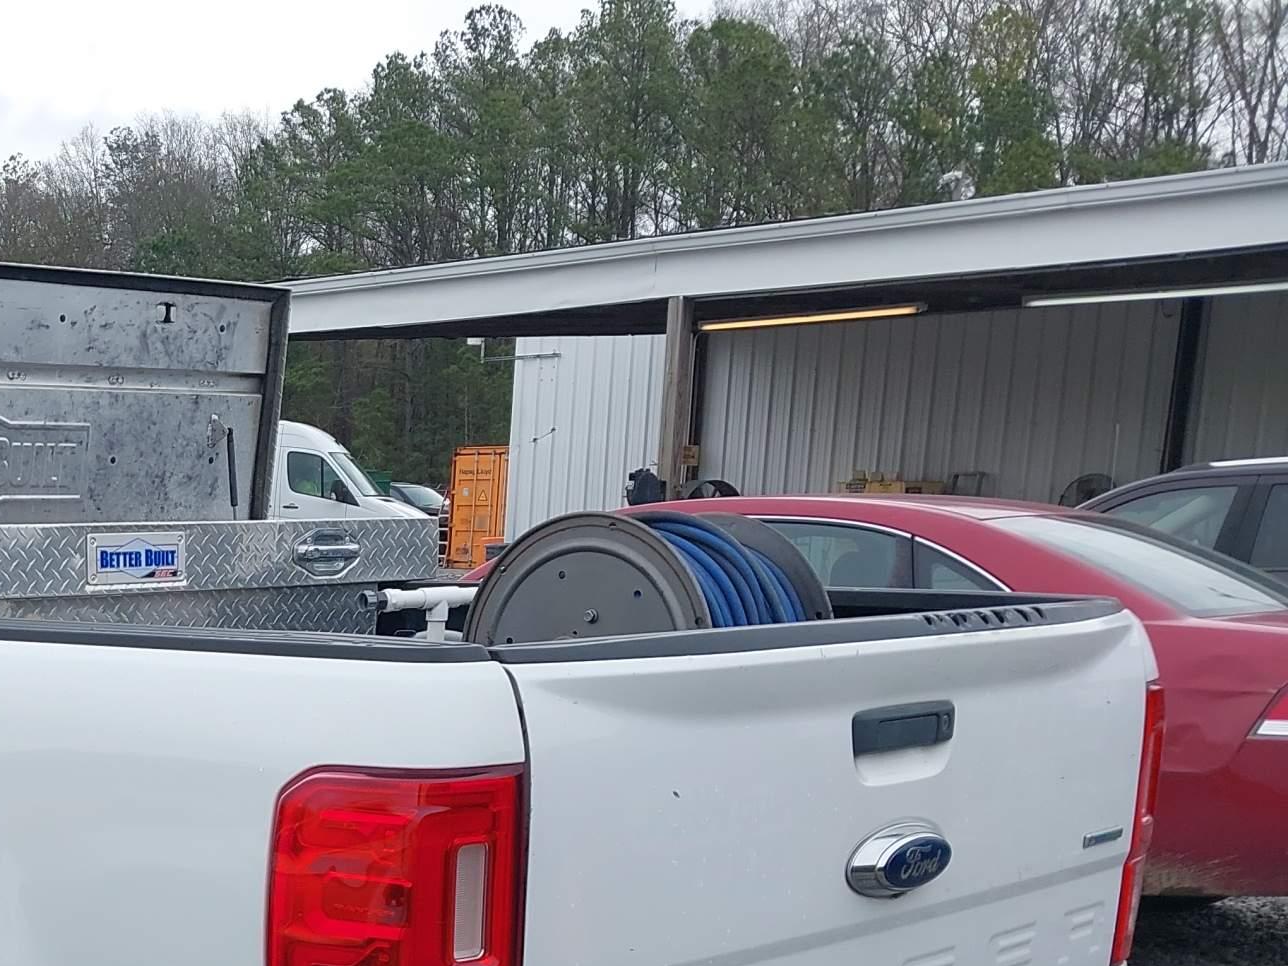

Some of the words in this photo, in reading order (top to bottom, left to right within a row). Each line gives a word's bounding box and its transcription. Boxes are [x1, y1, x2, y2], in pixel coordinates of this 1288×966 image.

[100, 550, 142, 569] BETTER
[145, 549, 177, 567] BUILT
[900, 844, 942, 880] Ford
